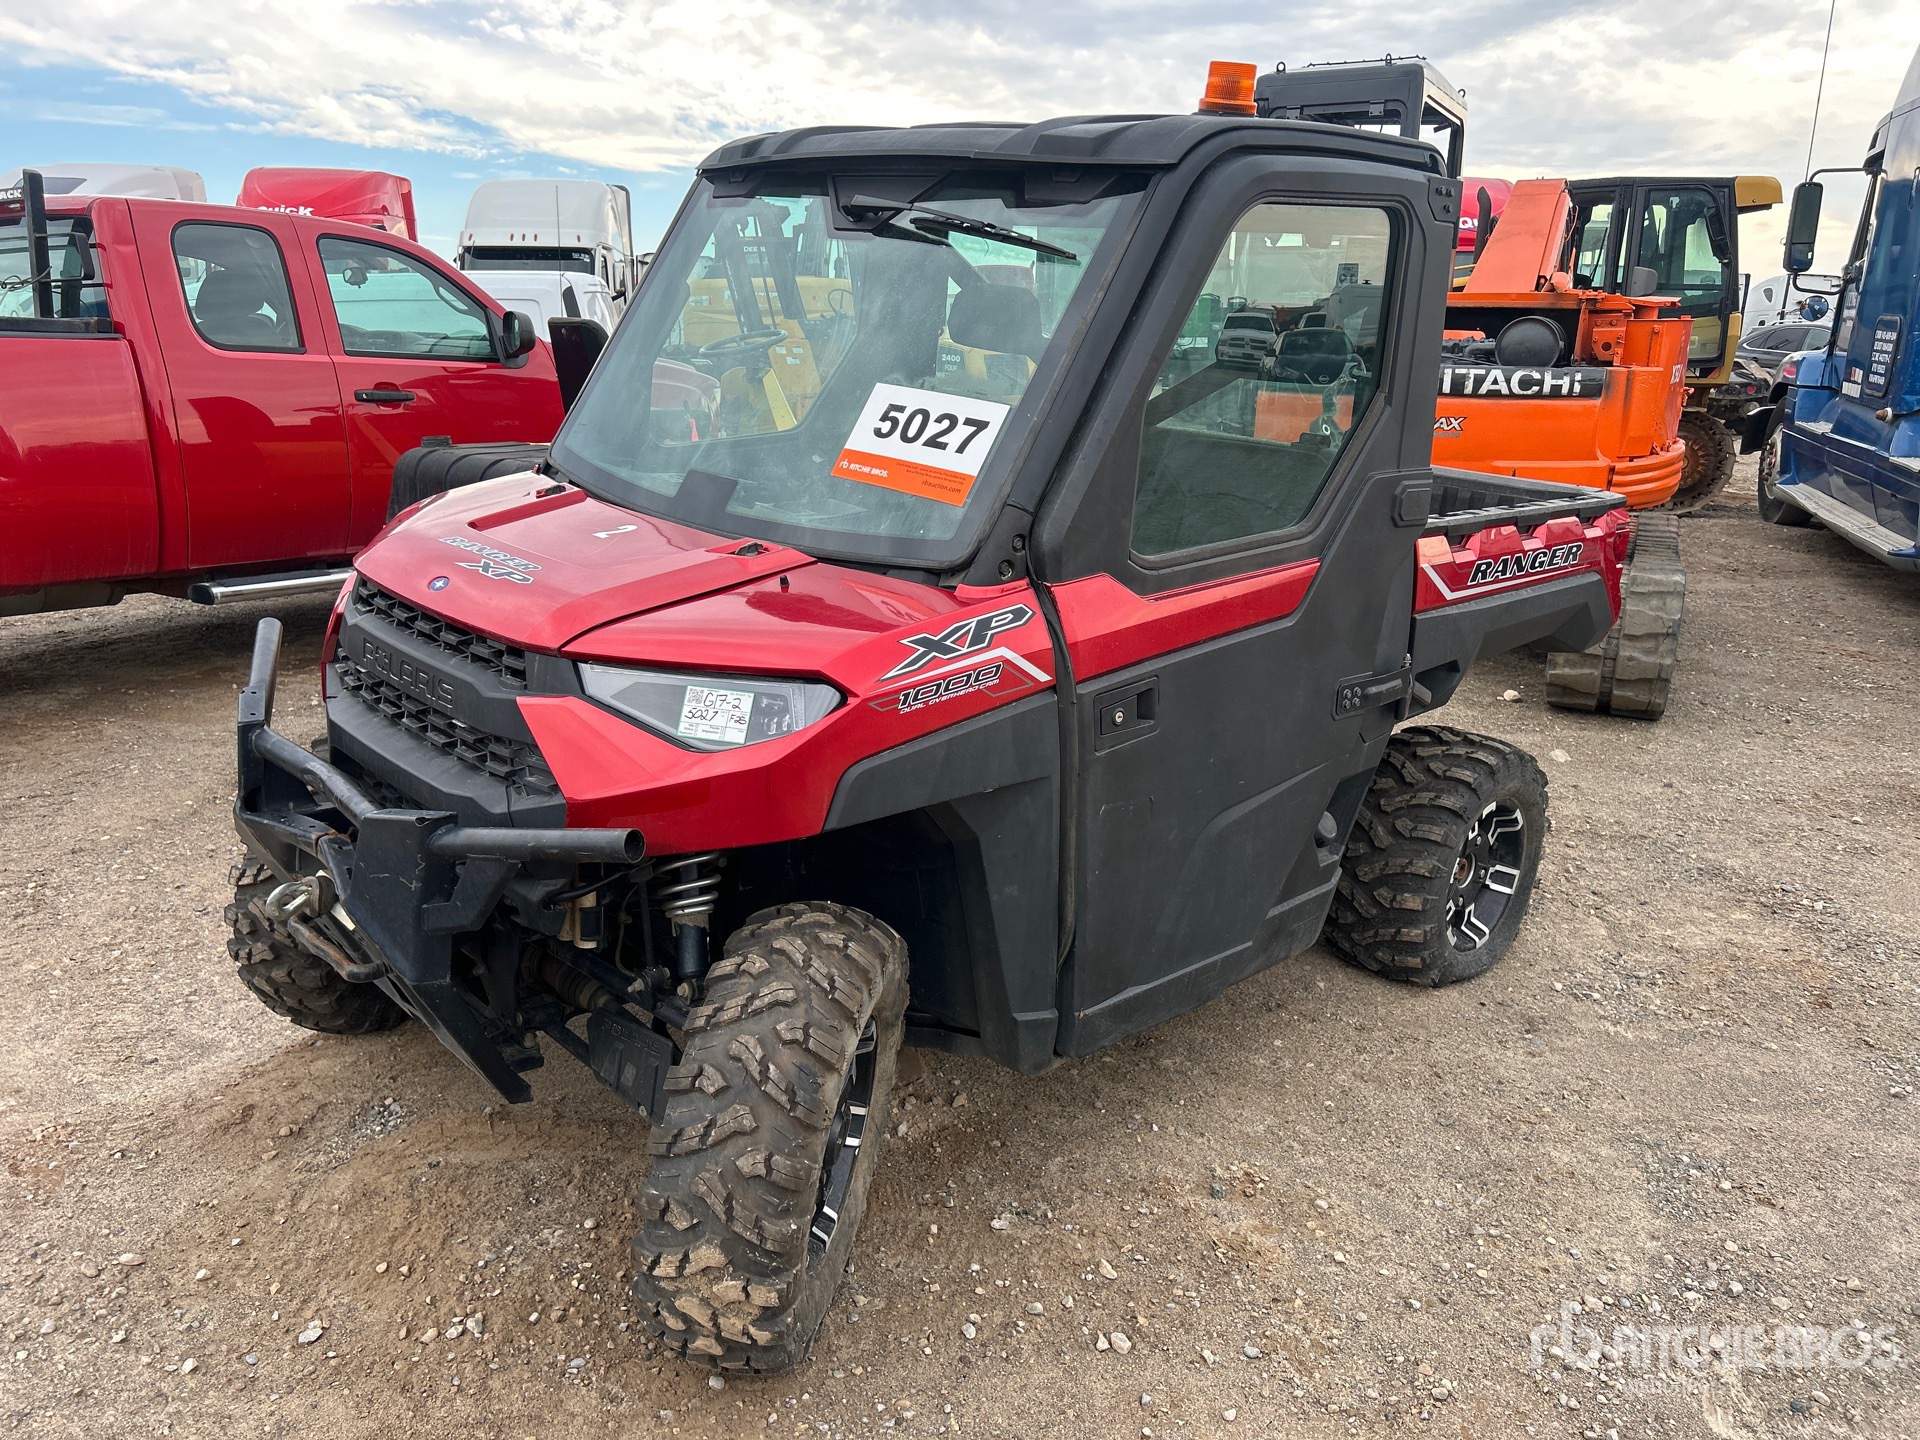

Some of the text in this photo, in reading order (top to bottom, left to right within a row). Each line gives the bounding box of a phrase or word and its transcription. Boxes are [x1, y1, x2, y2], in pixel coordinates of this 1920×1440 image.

[941, 353, 961, 363] 2400
[873, 402, 991, 455] 5027
[849, 462, 872, 474] RITCHIE
[921, 479, 962, 494] rbauction.com
[592, 524, 638, 539] 2
[438, 536, 542, 572] RANGER
[454, 558, 534, 584] XP
[1467, 542, 1583, 586] RANGER
[877, 603, 1037, 682] XP
[363, 637, 455, 709] POLARIS
[898, 661, 1005, 710] 1000
[899, 678, 1001, 715] DUAL OVERHEAD CAM
